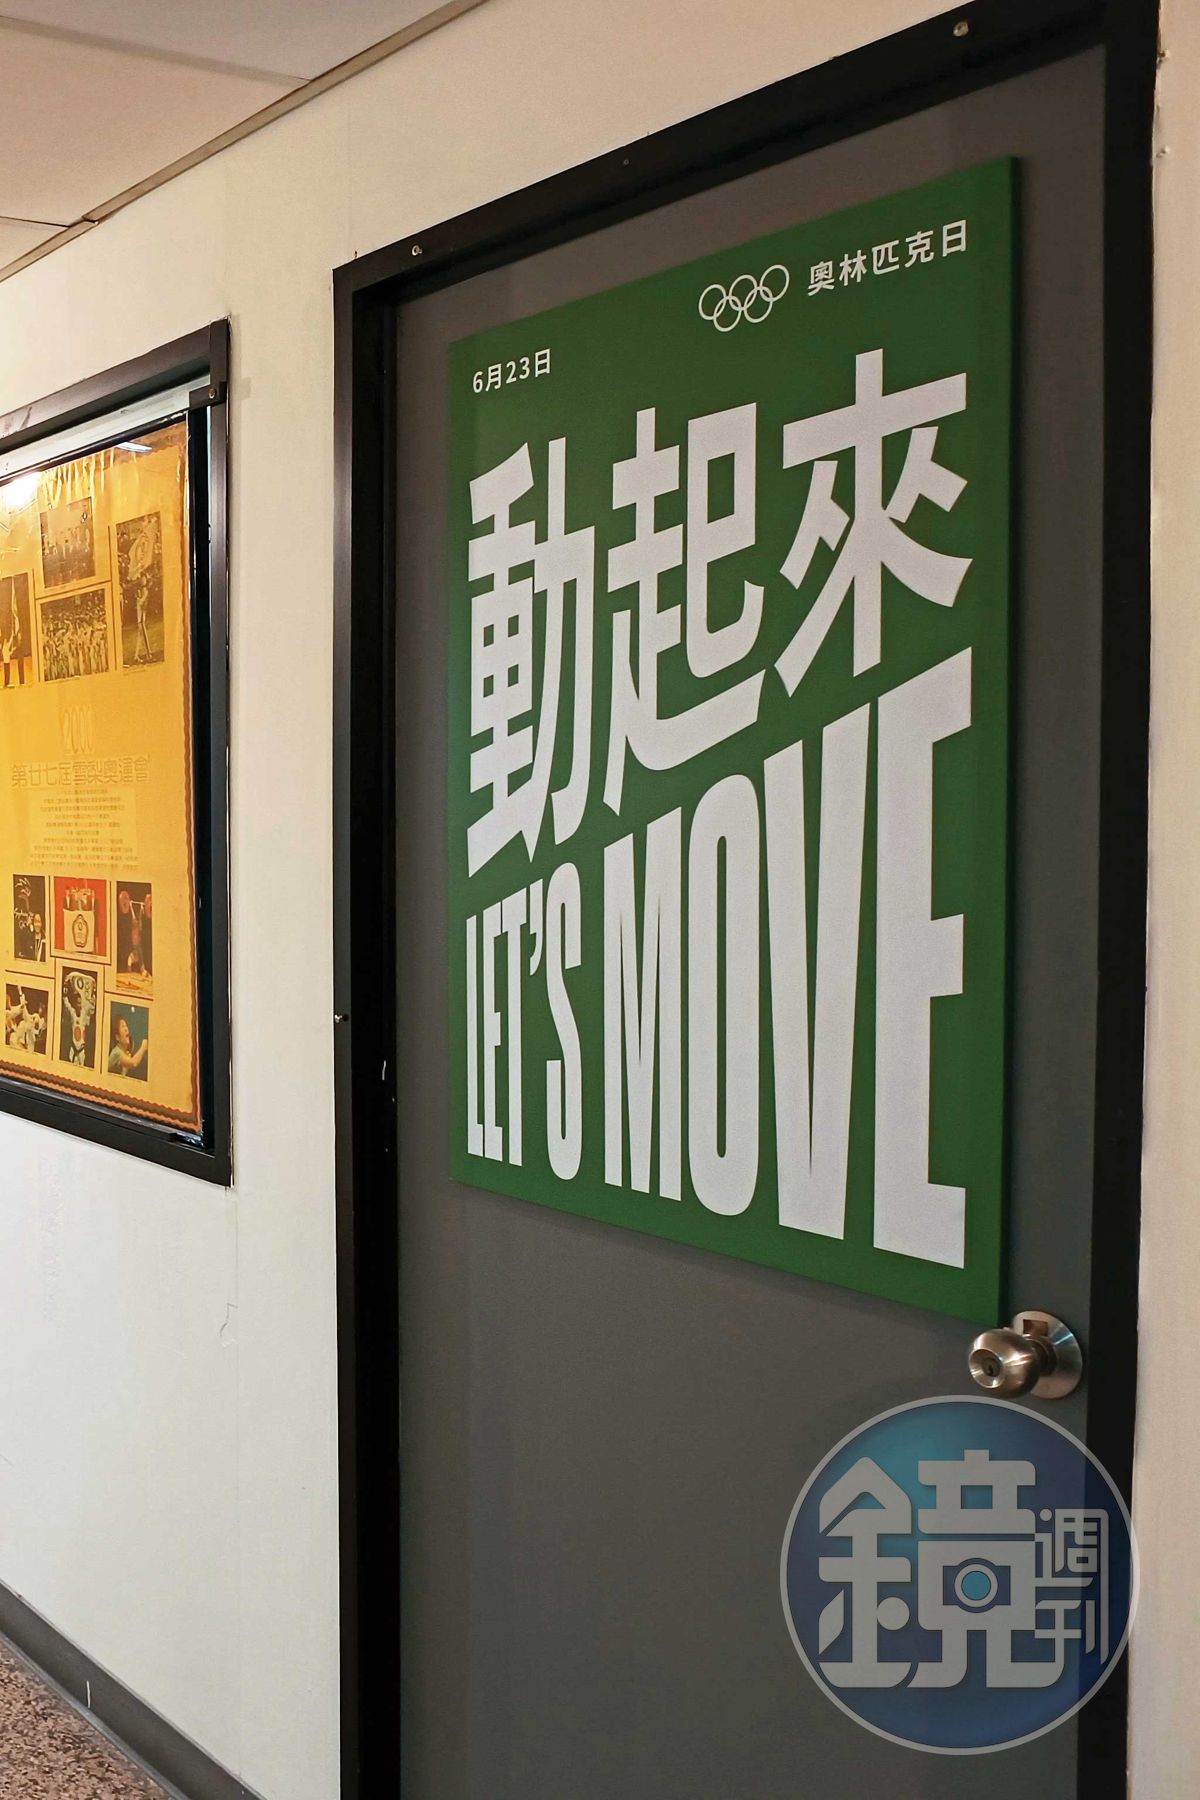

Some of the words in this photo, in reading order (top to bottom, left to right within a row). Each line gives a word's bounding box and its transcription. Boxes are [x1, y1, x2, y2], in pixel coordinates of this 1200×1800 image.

[471, 348, 552, 394] 6月23日
[806, 219, 968, 296] 奧林匹克日
[467, 348, 973, 877] 動起來
[467, 862, 582, 1180] LET'S
[604, 647, 972, 1269] MOVE
